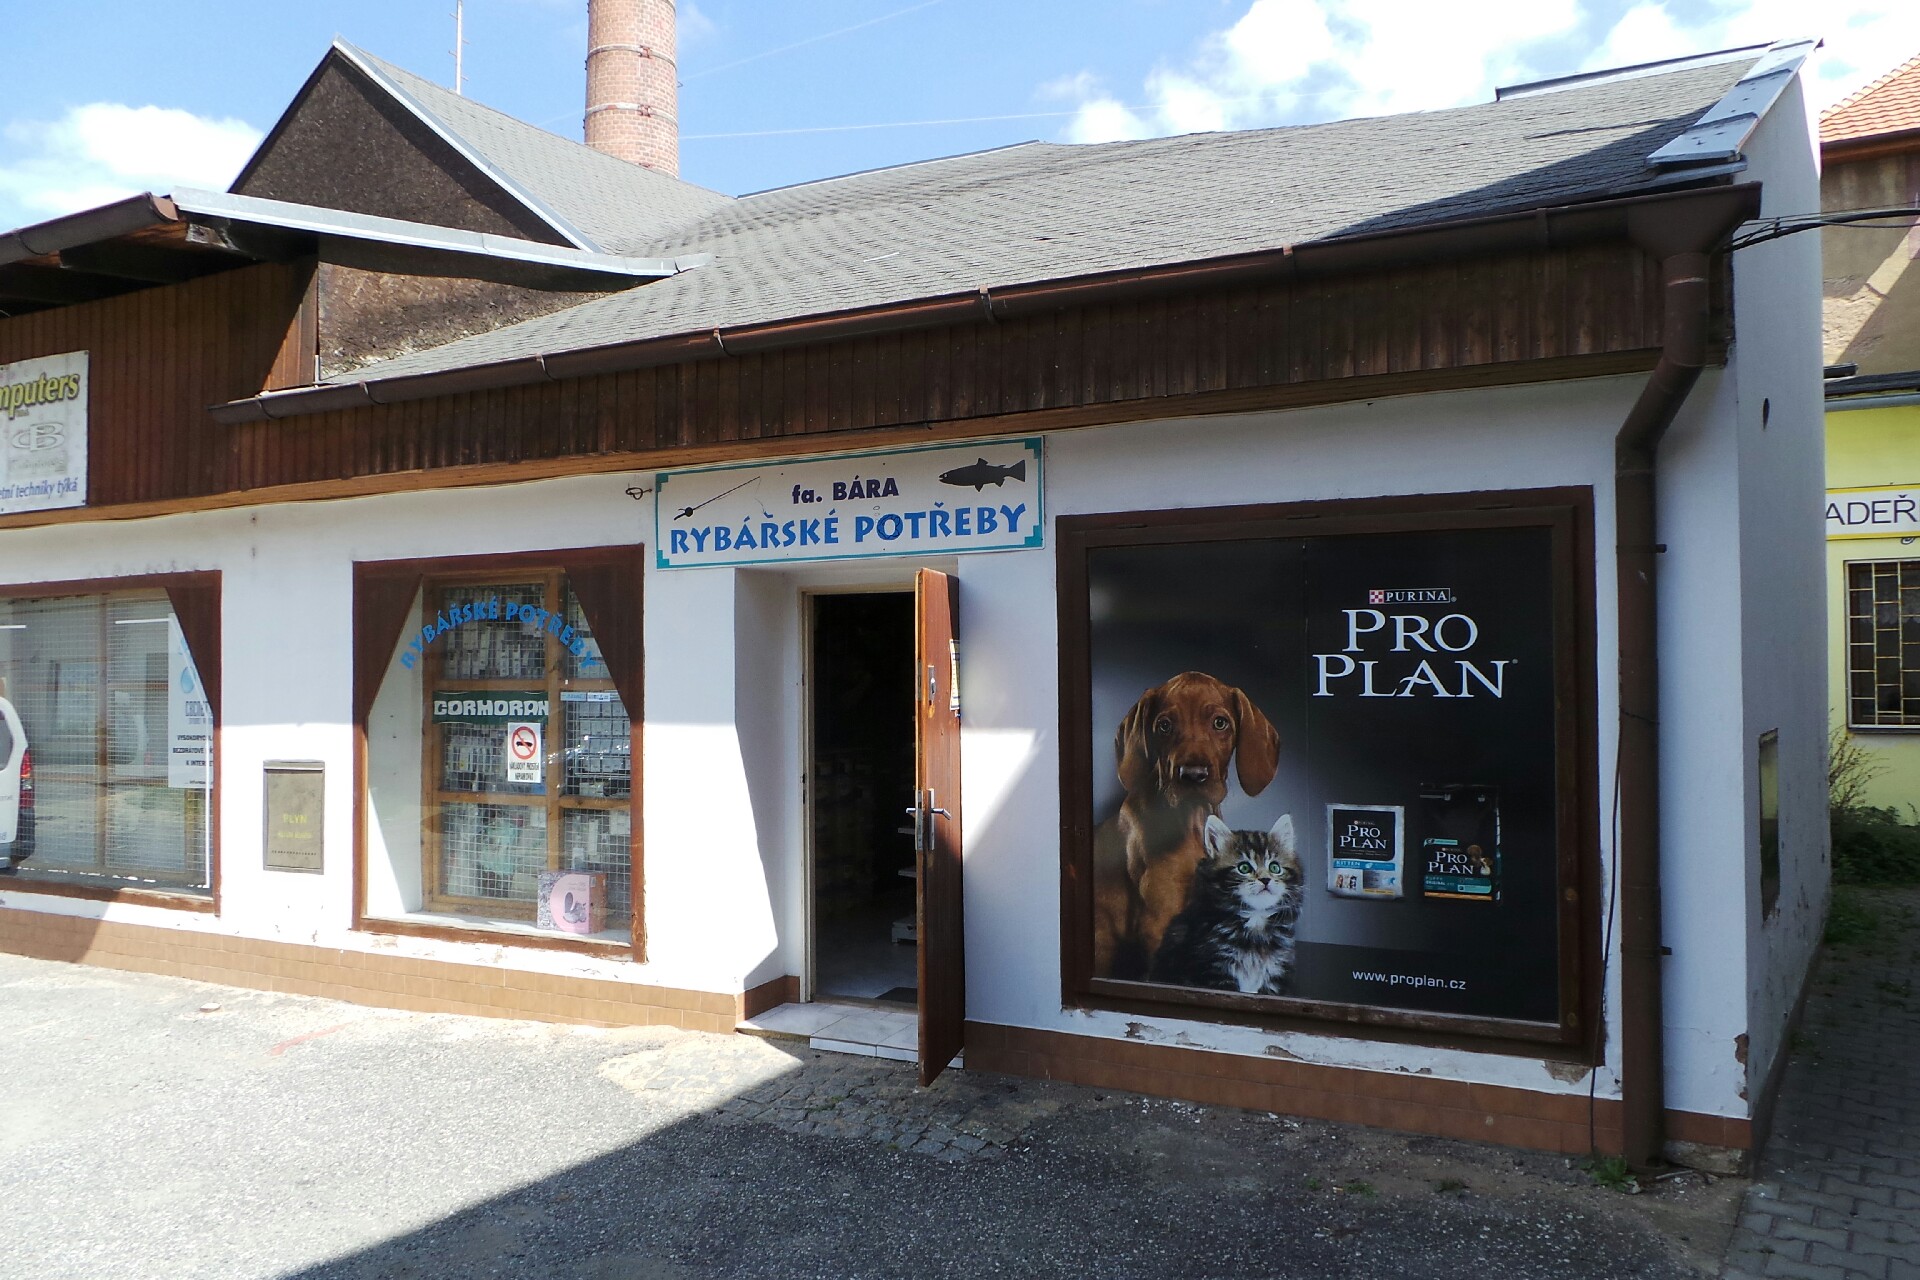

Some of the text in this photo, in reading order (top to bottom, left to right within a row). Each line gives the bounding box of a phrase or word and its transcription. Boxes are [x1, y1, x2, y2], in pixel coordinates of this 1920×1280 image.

[16, 480, 55, 499] techniky
[791, 475, 899, 505] fa. BÁRA
[670, 501, 1026, 555] RYBÁŘSKÉ POTŘEBY
[1386, 591, 1447, 602] PURINA
[401, 596, 599, 670] RYBÁŘSKÉ POTŘEBY
[1341, 609, 1478, 652] PRO
[1312, 654, 1510, 699] PLAN
[433, 700, 549, 716] CORMORAN
[283, 814, 308, 824] PLYN
[1347, 824, 1381, 838] PRO
[1339, 835, 1387, 849] PLAN
[1435, 851, 1468, 864] PRO
[1428, 862, 1474, 875] PLAN
[1352, 970, 1467, 990] www.proplan.cz
